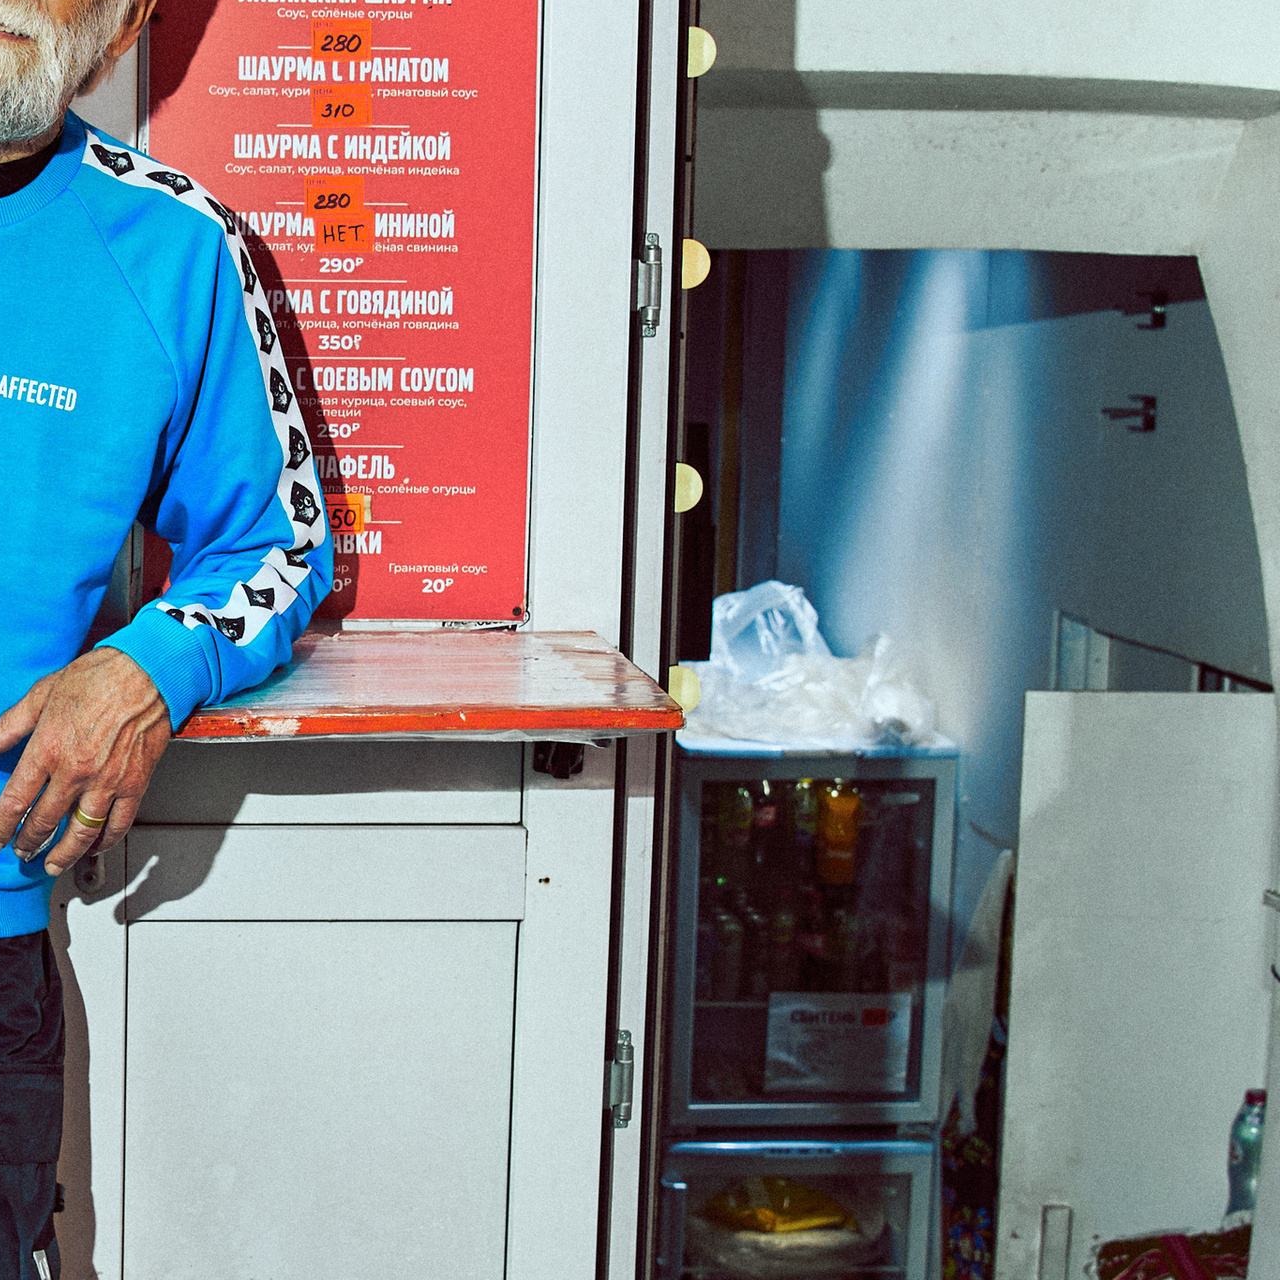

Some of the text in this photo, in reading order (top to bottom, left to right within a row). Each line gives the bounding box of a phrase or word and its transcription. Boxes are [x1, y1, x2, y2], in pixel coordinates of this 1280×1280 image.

[277, 7, 413, 21] Соус, солёные огурцы
[320, 34, 362, 53] 280
[238, 56, 327, 81] ШАУРМА
[208, 85, 479, 100] Соус, салат, кури гранатовый соус
[320, 103, 355, 117] 310
[234, 131, 451, 164] ШАУРМА С ИНДЕЙКОЙ
[225, 162, 460, 176] Соус, салат, курица, копчёная индейка
[314, 193, 351, 210] 280
[375, 209, 455, 238] ИНИНОЙ
[258, 241, 294, 252] салат,
[406, 243, 459, 253] свинина
[320, 290, 331, 314] С
[337, 286, 454, 319] ГОВЯДИНОЙ
[293, 320, 339, 331] курица,
[343, 318, 400, 329] копчёная
[403, 321, 460, 331] говядина
[296, 367, 475, 392] С СОЕВЫМ СОУСОМ
[341, 397, 388, 409] курица,
[390, 396, 435, 407] соевый
[438, 399, 468, 409] соус,
[316, 408, 362, 419] специи
[315, 455, 396, 480] ЛАФЕЛЬ
[377, 483, 429, 494] солёные
[432, 485, 476, 496] огурцы
[327, 508, 357, 530] 50
[388, 563, 488, 576] Гранатовый соус
